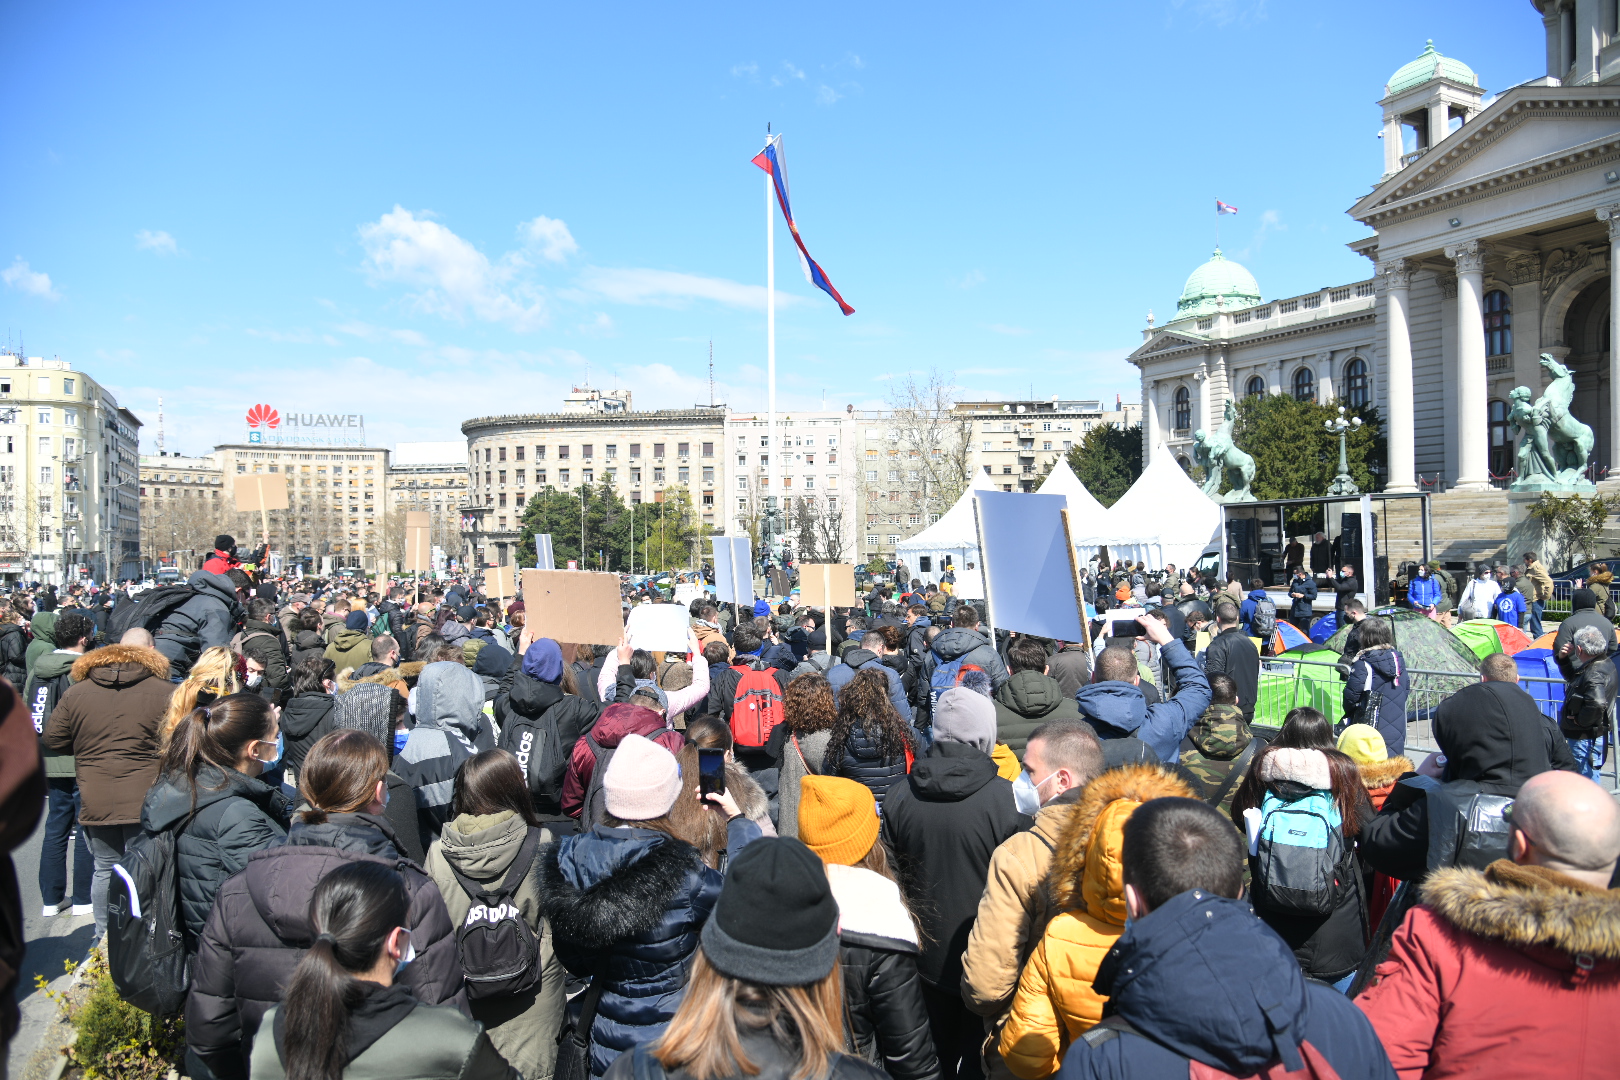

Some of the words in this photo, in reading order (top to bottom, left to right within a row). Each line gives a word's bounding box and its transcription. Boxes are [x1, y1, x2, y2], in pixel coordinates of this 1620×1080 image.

[286, 413, 364, 427] HUAWEI
[32, 687, 48, 734] adidas
[488, 903, 507, 923] DO
